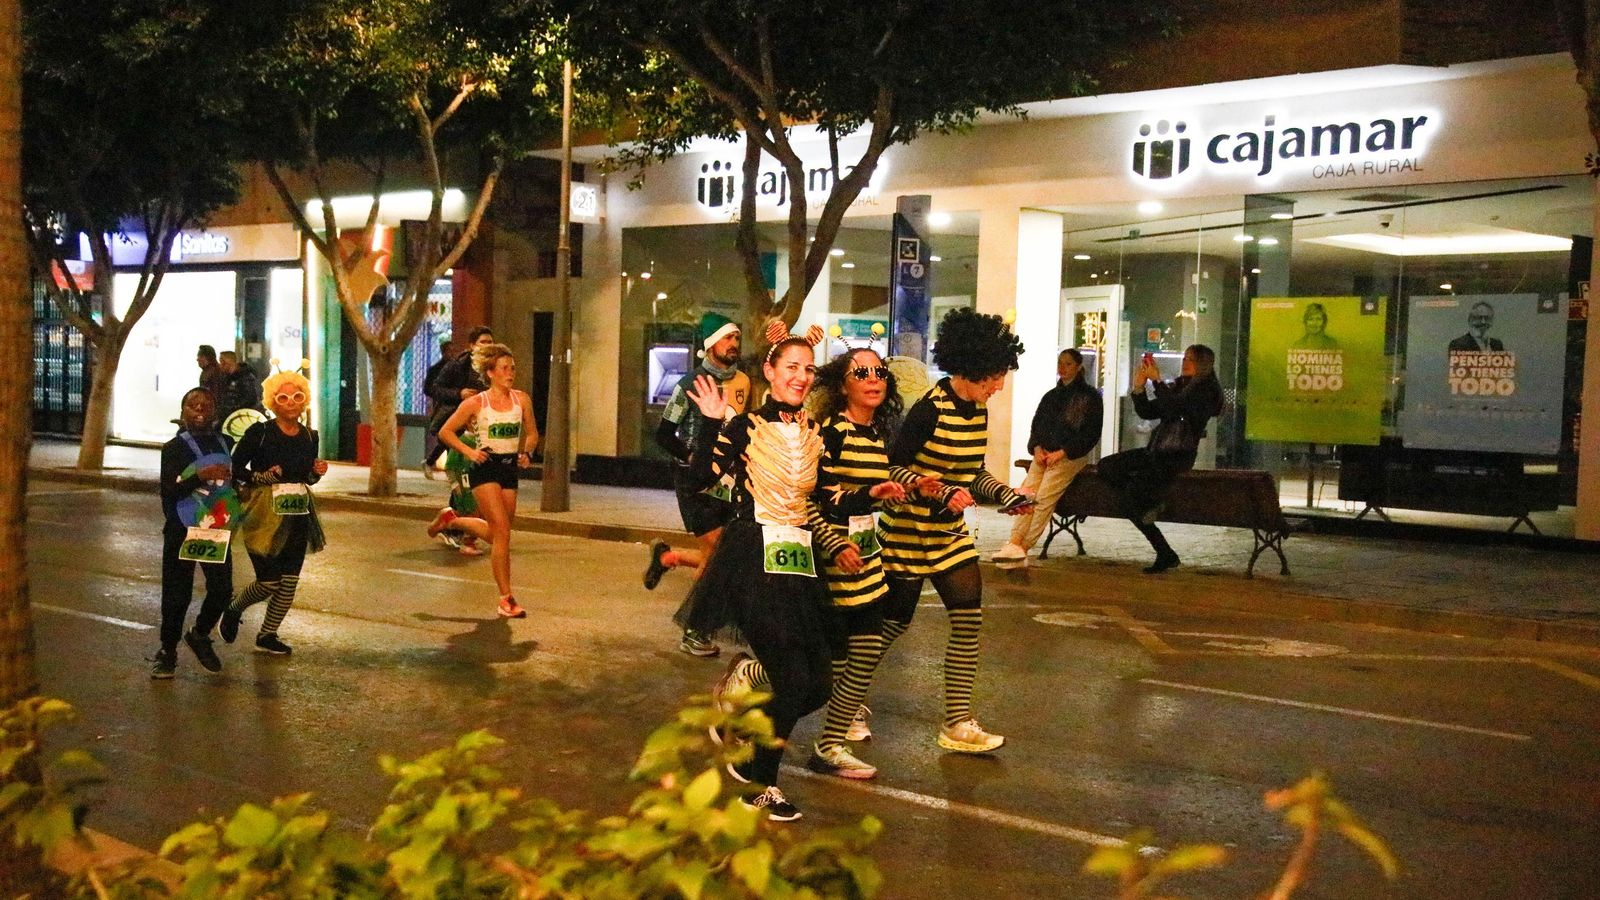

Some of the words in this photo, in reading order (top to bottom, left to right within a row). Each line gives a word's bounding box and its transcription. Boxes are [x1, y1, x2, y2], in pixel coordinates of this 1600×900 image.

[1206, 115, 1428, 177] cajamar
[1312, 162, 1357, 180] CAJA
[1363, 157, 1424, 175] RURAL
[182, 231, 230, 255] Sanitas
[1286, 374, 1343, 391] TODO
[1449, 367, 1466, 378] LO
[1470, 367, 1516, 378] TIENES
[1448, 378, 1516, 396] TODO
[775, 549, 808, 569] 613
